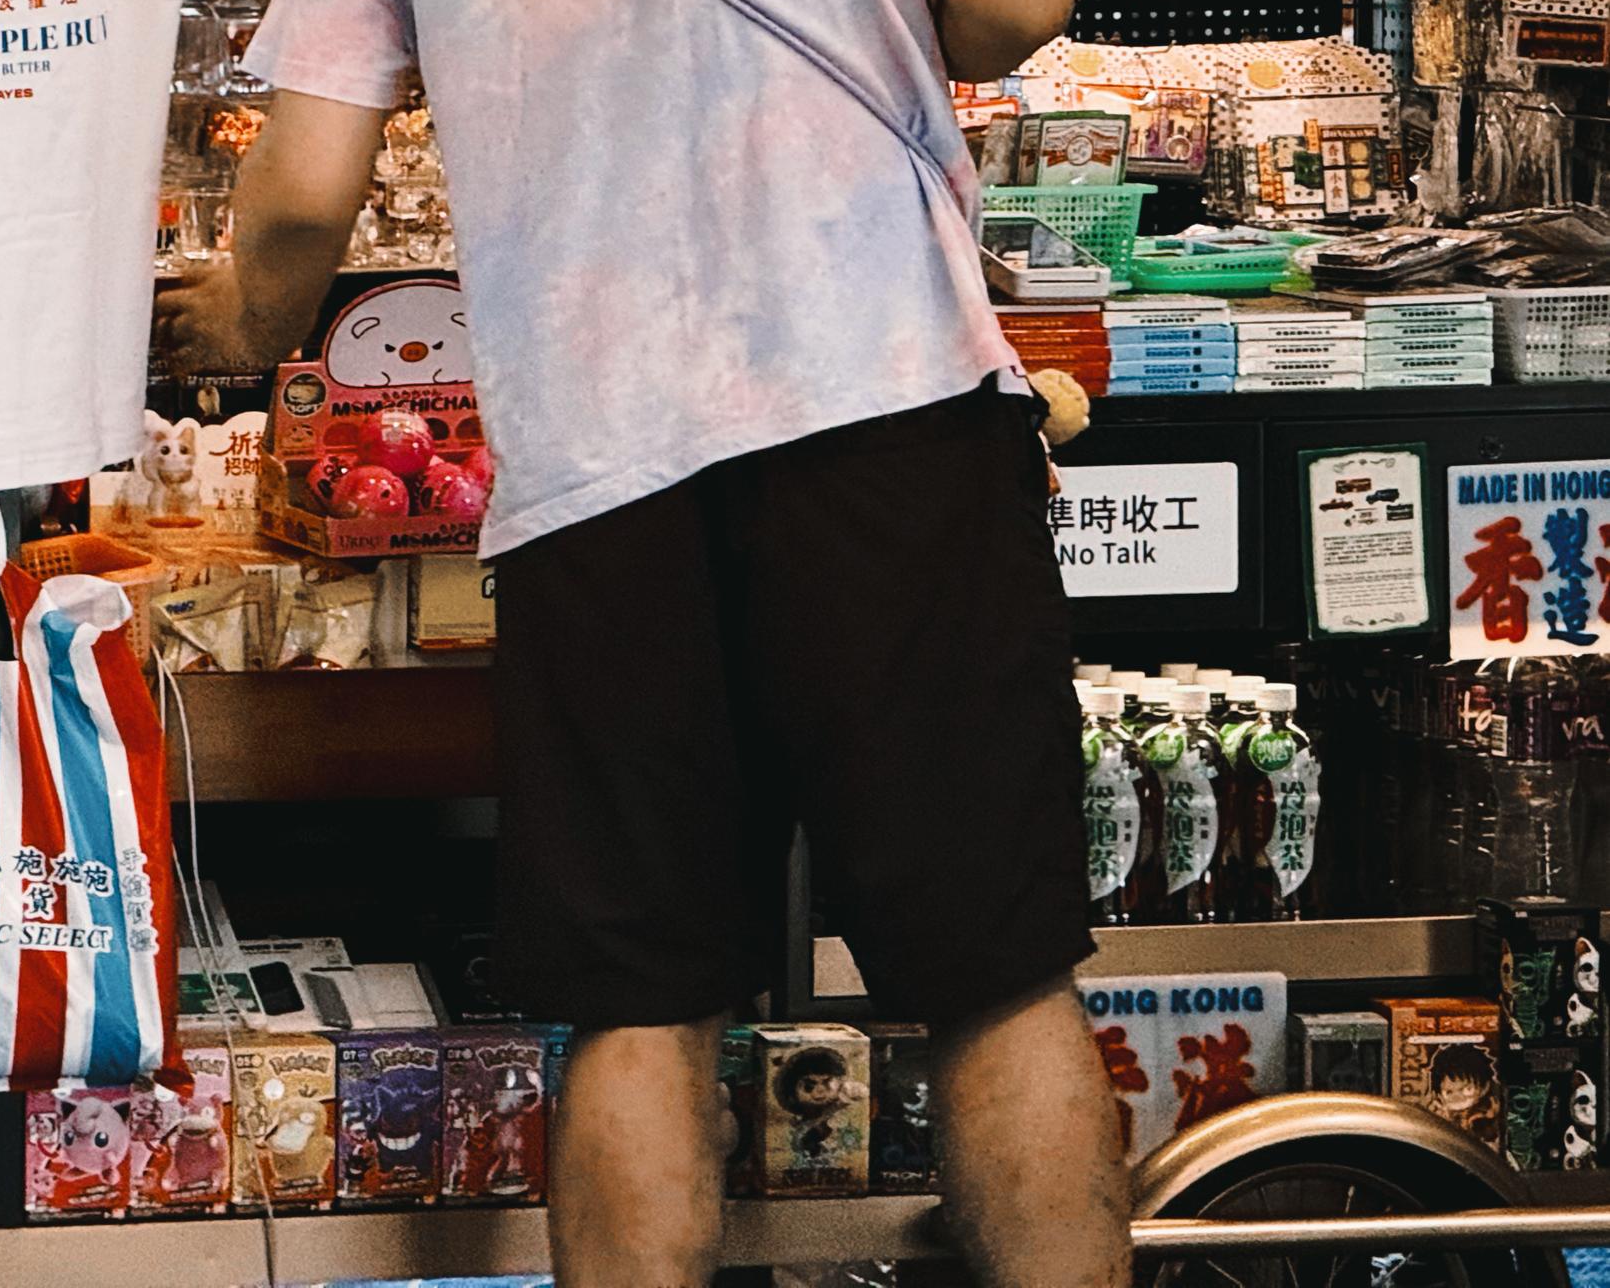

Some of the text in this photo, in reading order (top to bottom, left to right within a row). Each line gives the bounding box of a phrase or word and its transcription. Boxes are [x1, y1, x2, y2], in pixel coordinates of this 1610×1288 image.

[1457, 474, 1519, 505] MADE
[1523, 473, 1547, 503] IN
[1046, 493, 1201, 536] 準時收工
[1058, 539, 1157, 566] No Talk
[1454, 514, 1545, 645] 香
[1542, 507, 1602, 648] 製造
[1167, 779, 1195, 872] 冷泡茶
[1279, 780, 1307, 871] 冷泡茶
[17, 922, 111, 951] SELECT
[1169, 985, 1265, 1015] KONG
